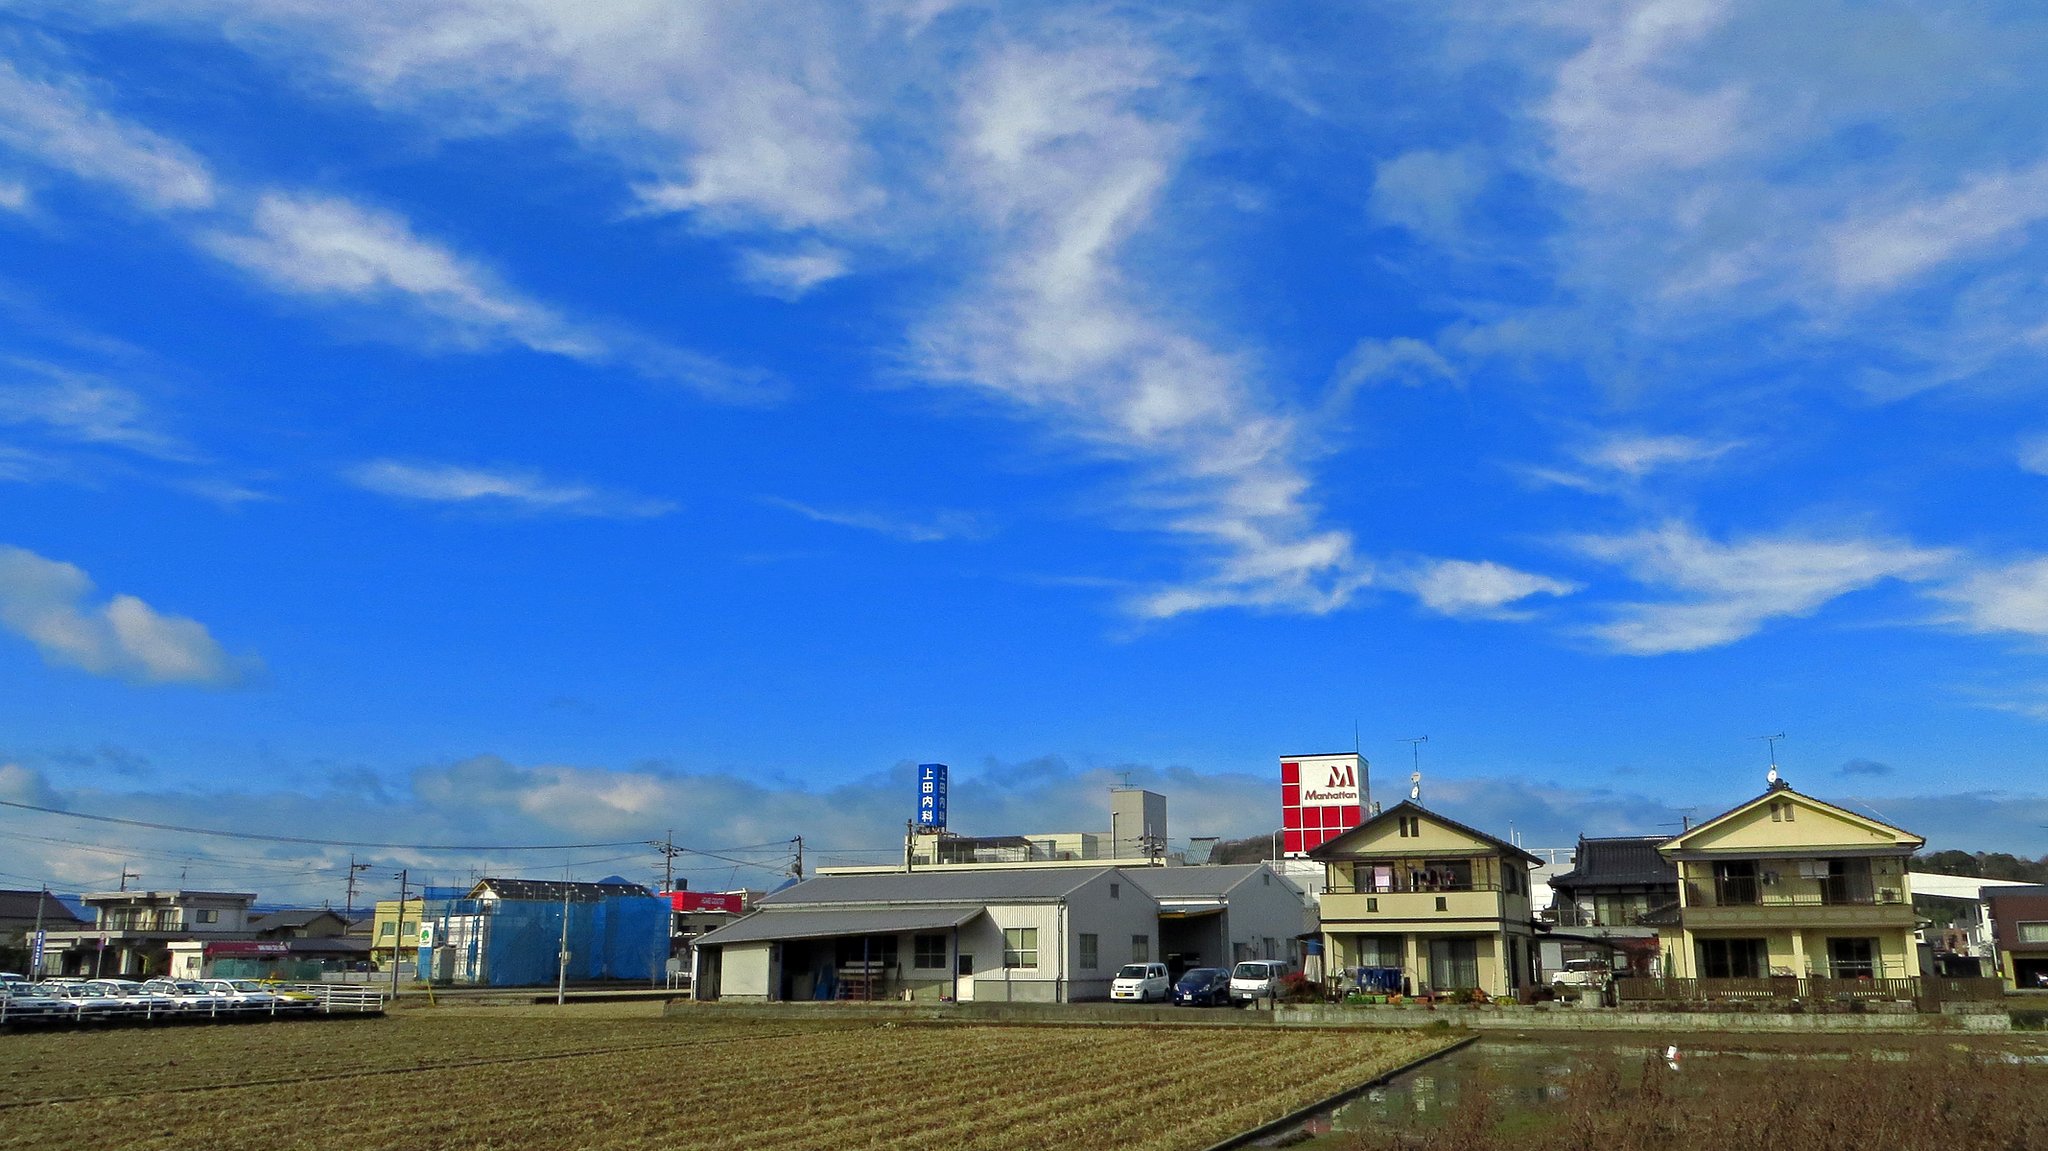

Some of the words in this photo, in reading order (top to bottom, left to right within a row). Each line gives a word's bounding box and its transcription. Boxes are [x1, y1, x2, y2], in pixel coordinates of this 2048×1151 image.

[922, 767, 934, 822] 上田内科
[1304, 790, 1357, 800] Manhattan
